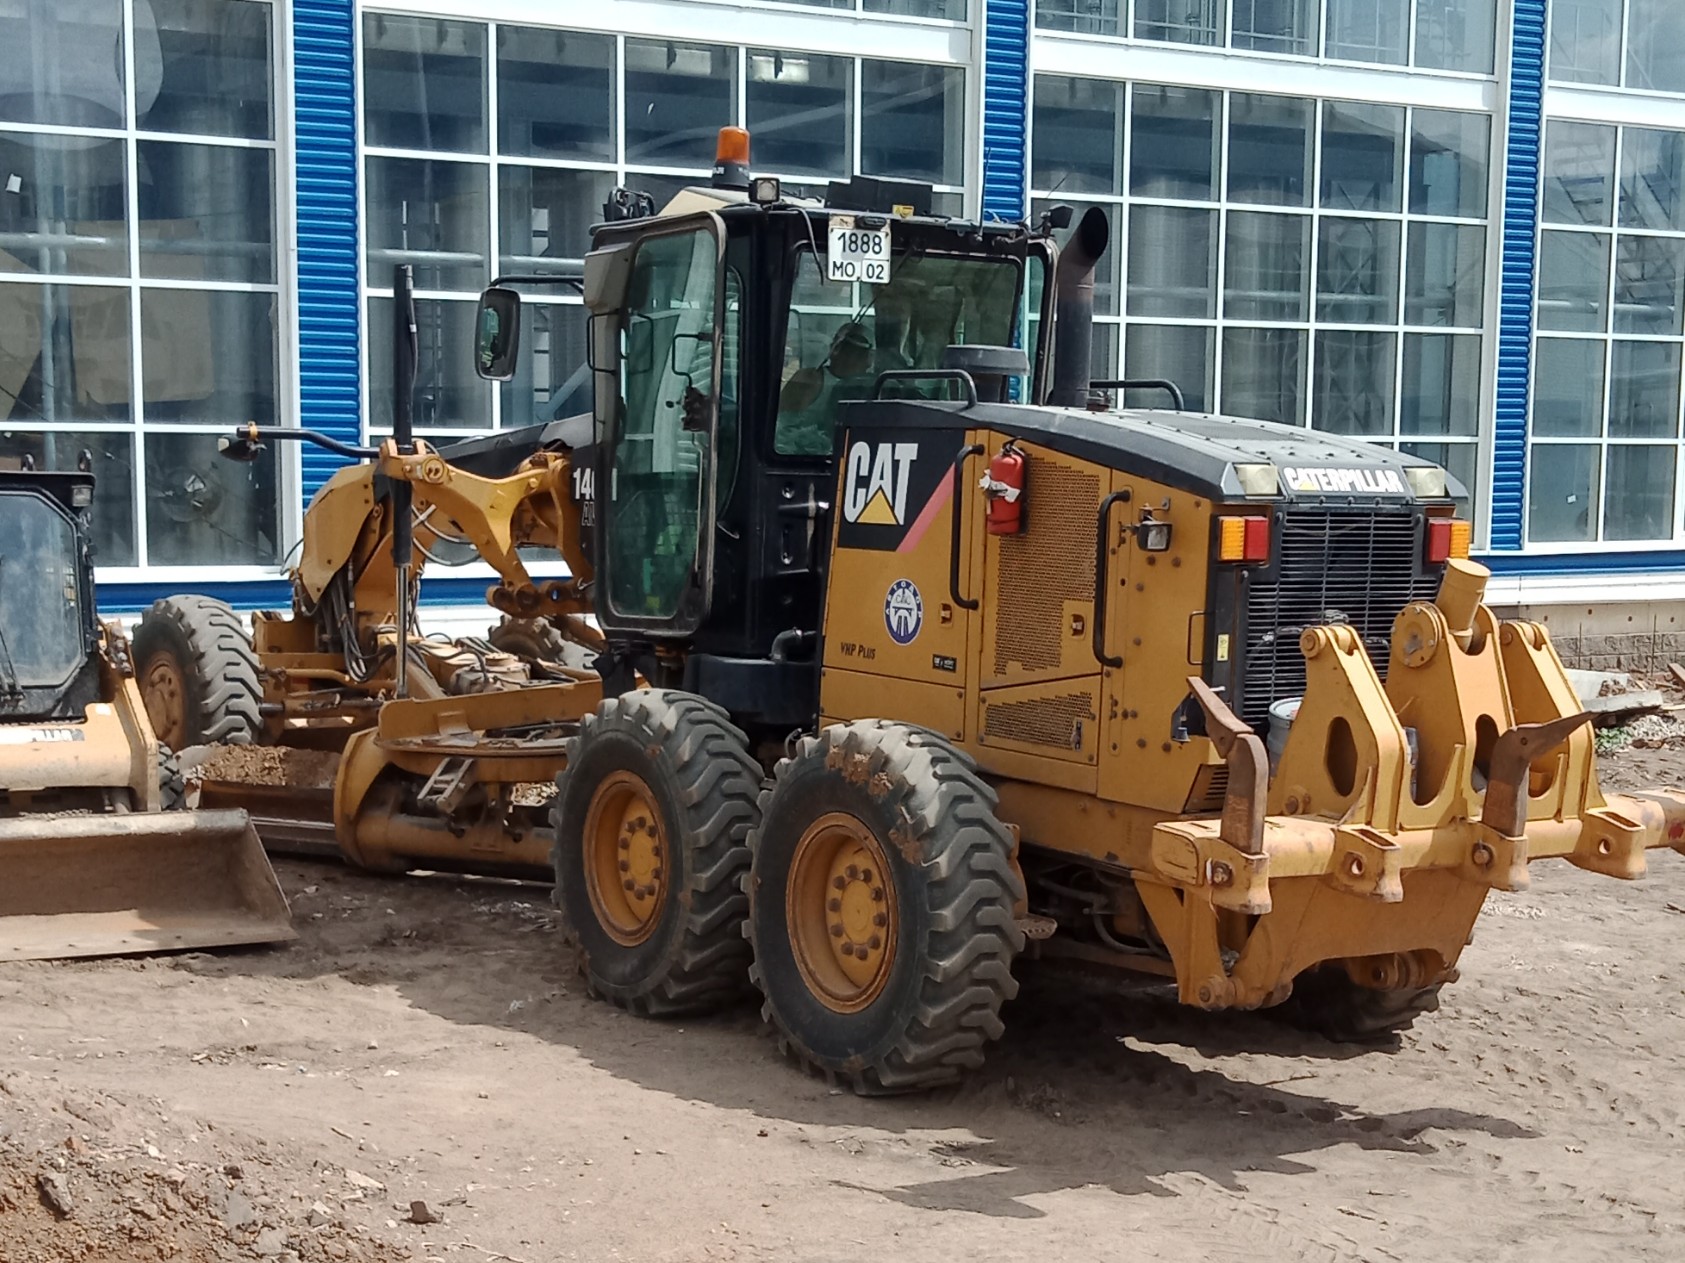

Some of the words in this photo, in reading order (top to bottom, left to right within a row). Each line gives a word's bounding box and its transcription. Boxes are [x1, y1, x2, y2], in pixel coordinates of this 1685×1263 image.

[837, 232, 882, 255] 1888
[866, 263, 885, 280] 02
[844, 441, 919, 525] CAT
[1283, 466, 1405, 493] CATERPILLAR
[840, 641, 857, 656] VHP
